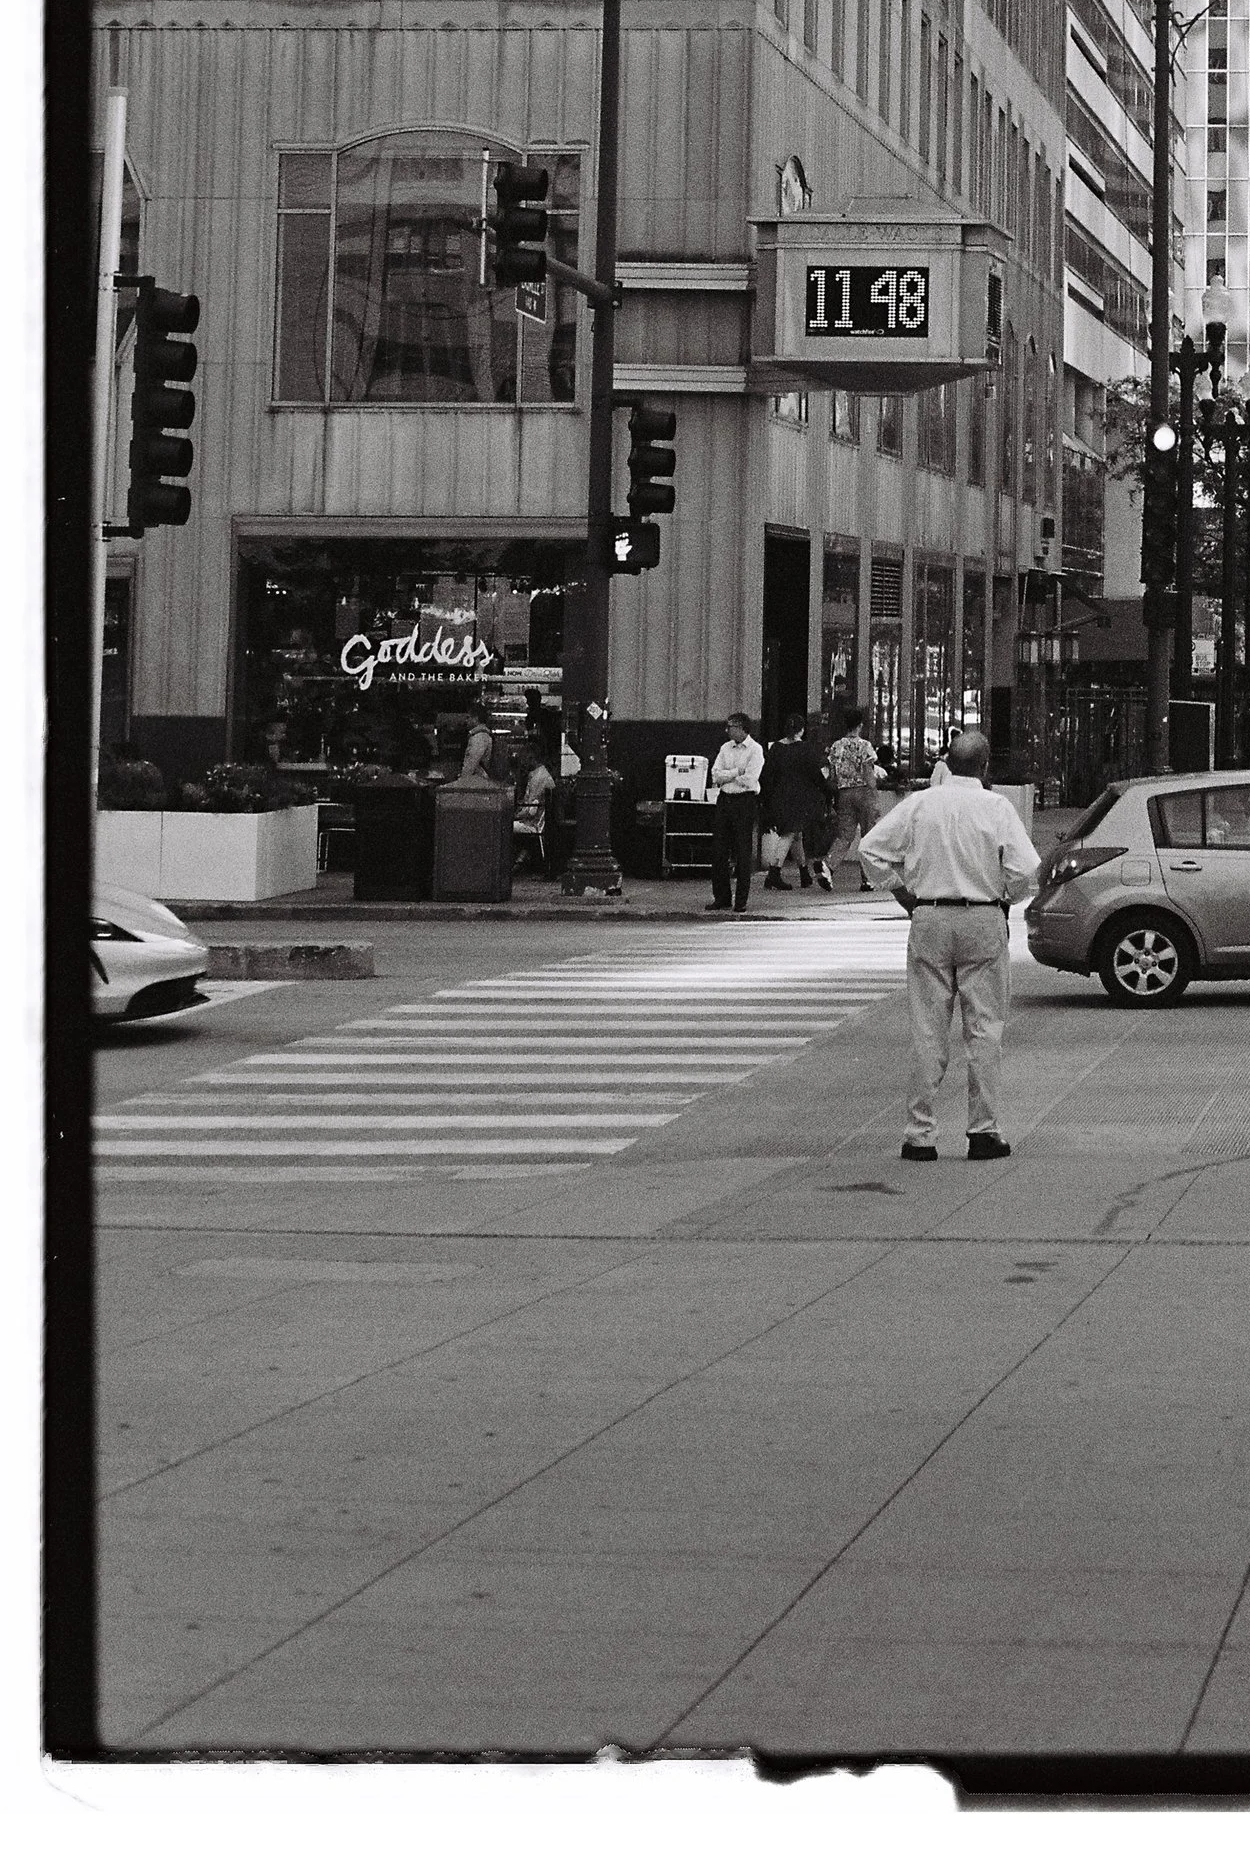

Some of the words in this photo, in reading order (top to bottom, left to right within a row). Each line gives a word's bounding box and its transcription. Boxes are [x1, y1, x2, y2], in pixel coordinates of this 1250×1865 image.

[340, 622, 494, 691] Goddess
[389, 672, 415, 682] AND
[421, 672, 444, 682] THE
[449, 672, 489, 682] BAKER
